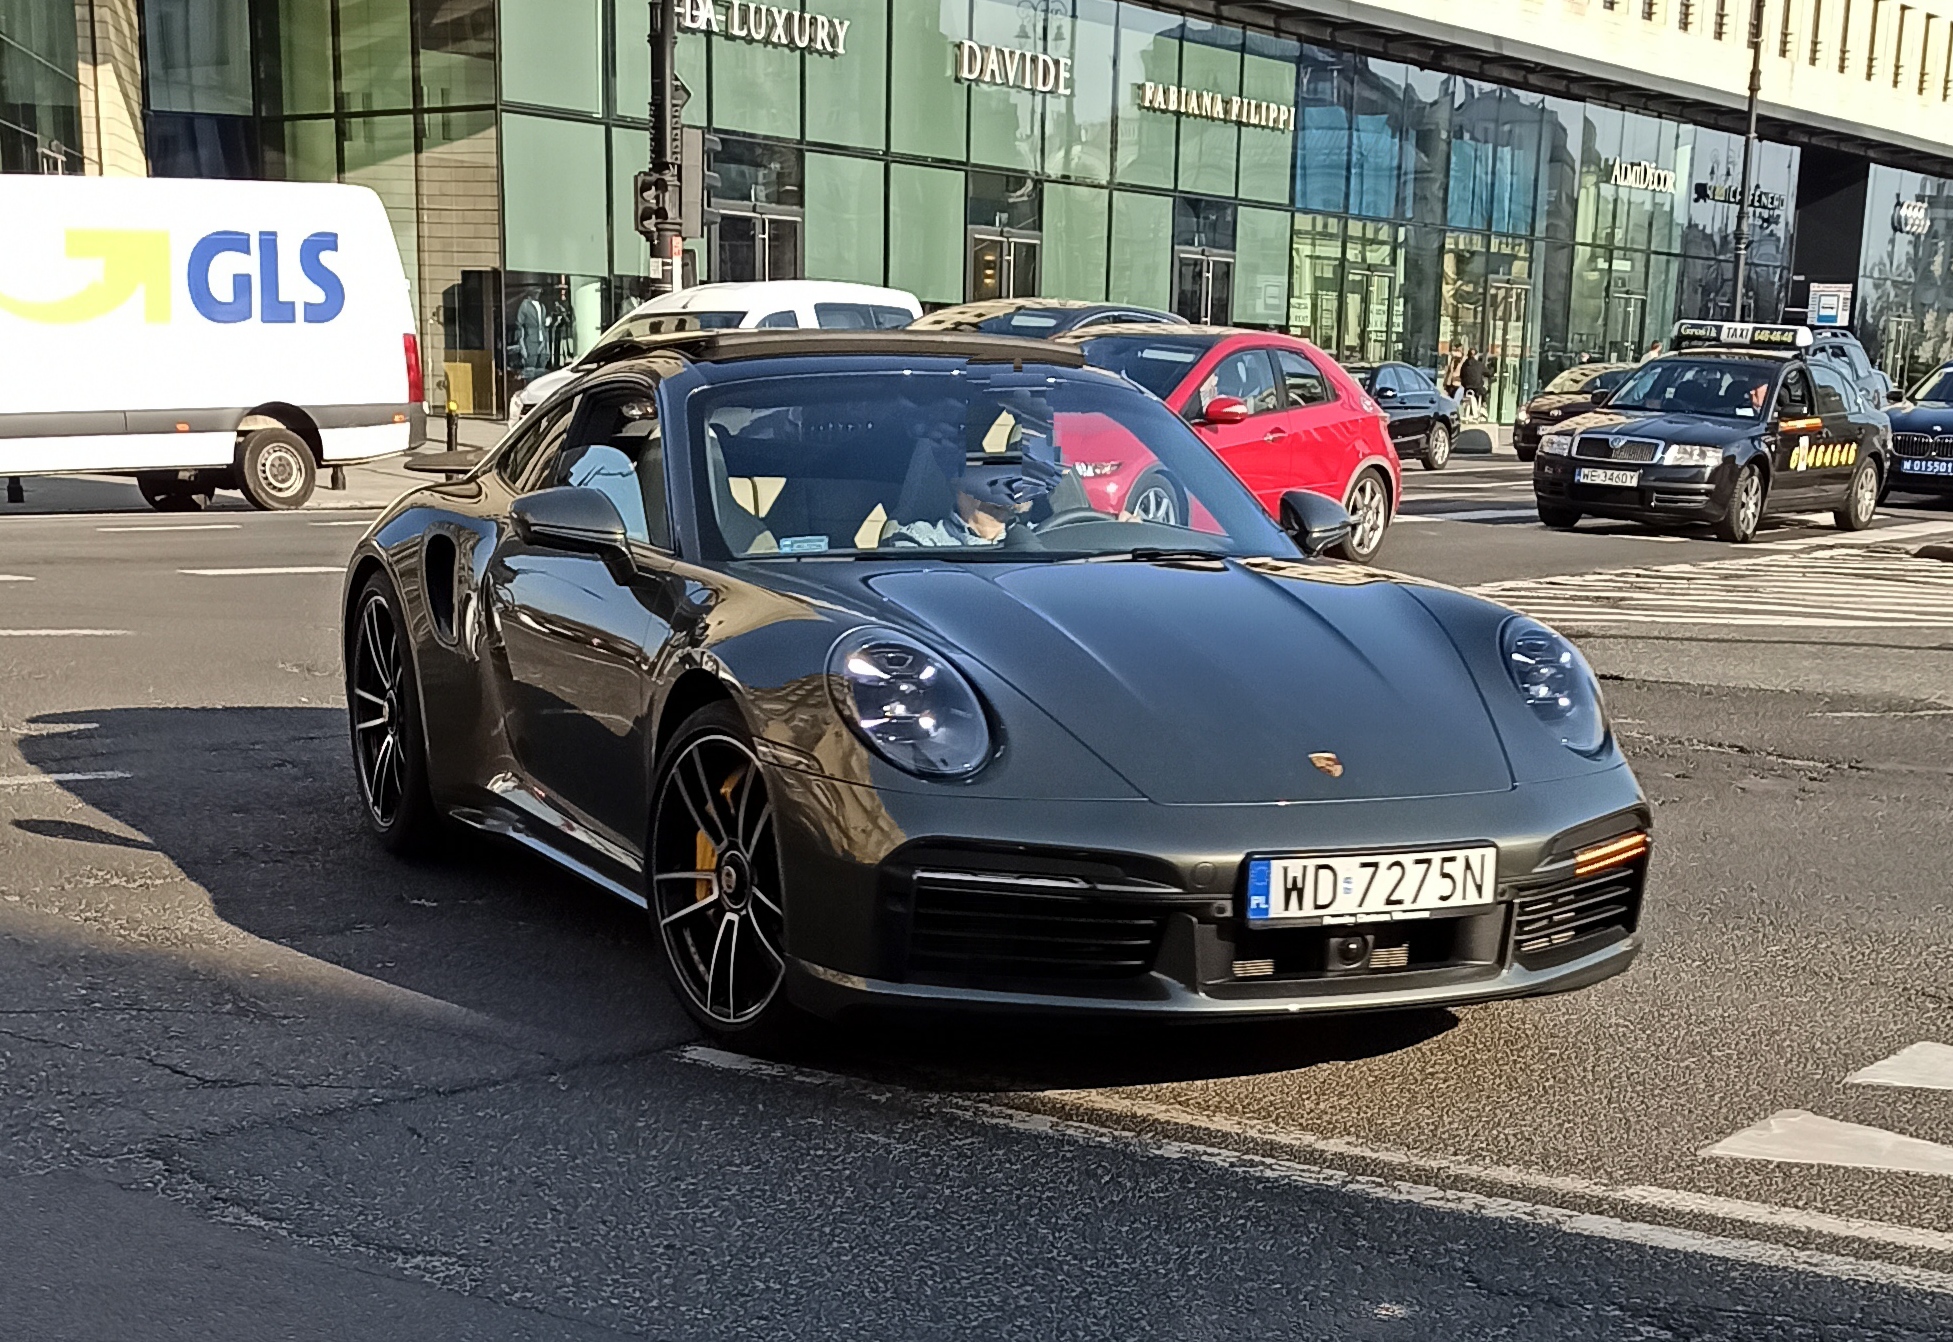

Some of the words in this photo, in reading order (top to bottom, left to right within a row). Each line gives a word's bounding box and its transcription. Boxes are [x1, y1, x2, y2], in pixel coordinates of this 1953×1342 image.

[960, 39, 1071, 95] DAVIDE
[1143, 81, 1225, 119] FABIANA
[1230, 96, 1296, 131] FILIPPI
[187, 230, 345, 323] GLS
[1726, 327, 1749, 339] TAXI
[1283, 864, 1338, 911] WD
[1356, 853, 1486, 907] 7275N
